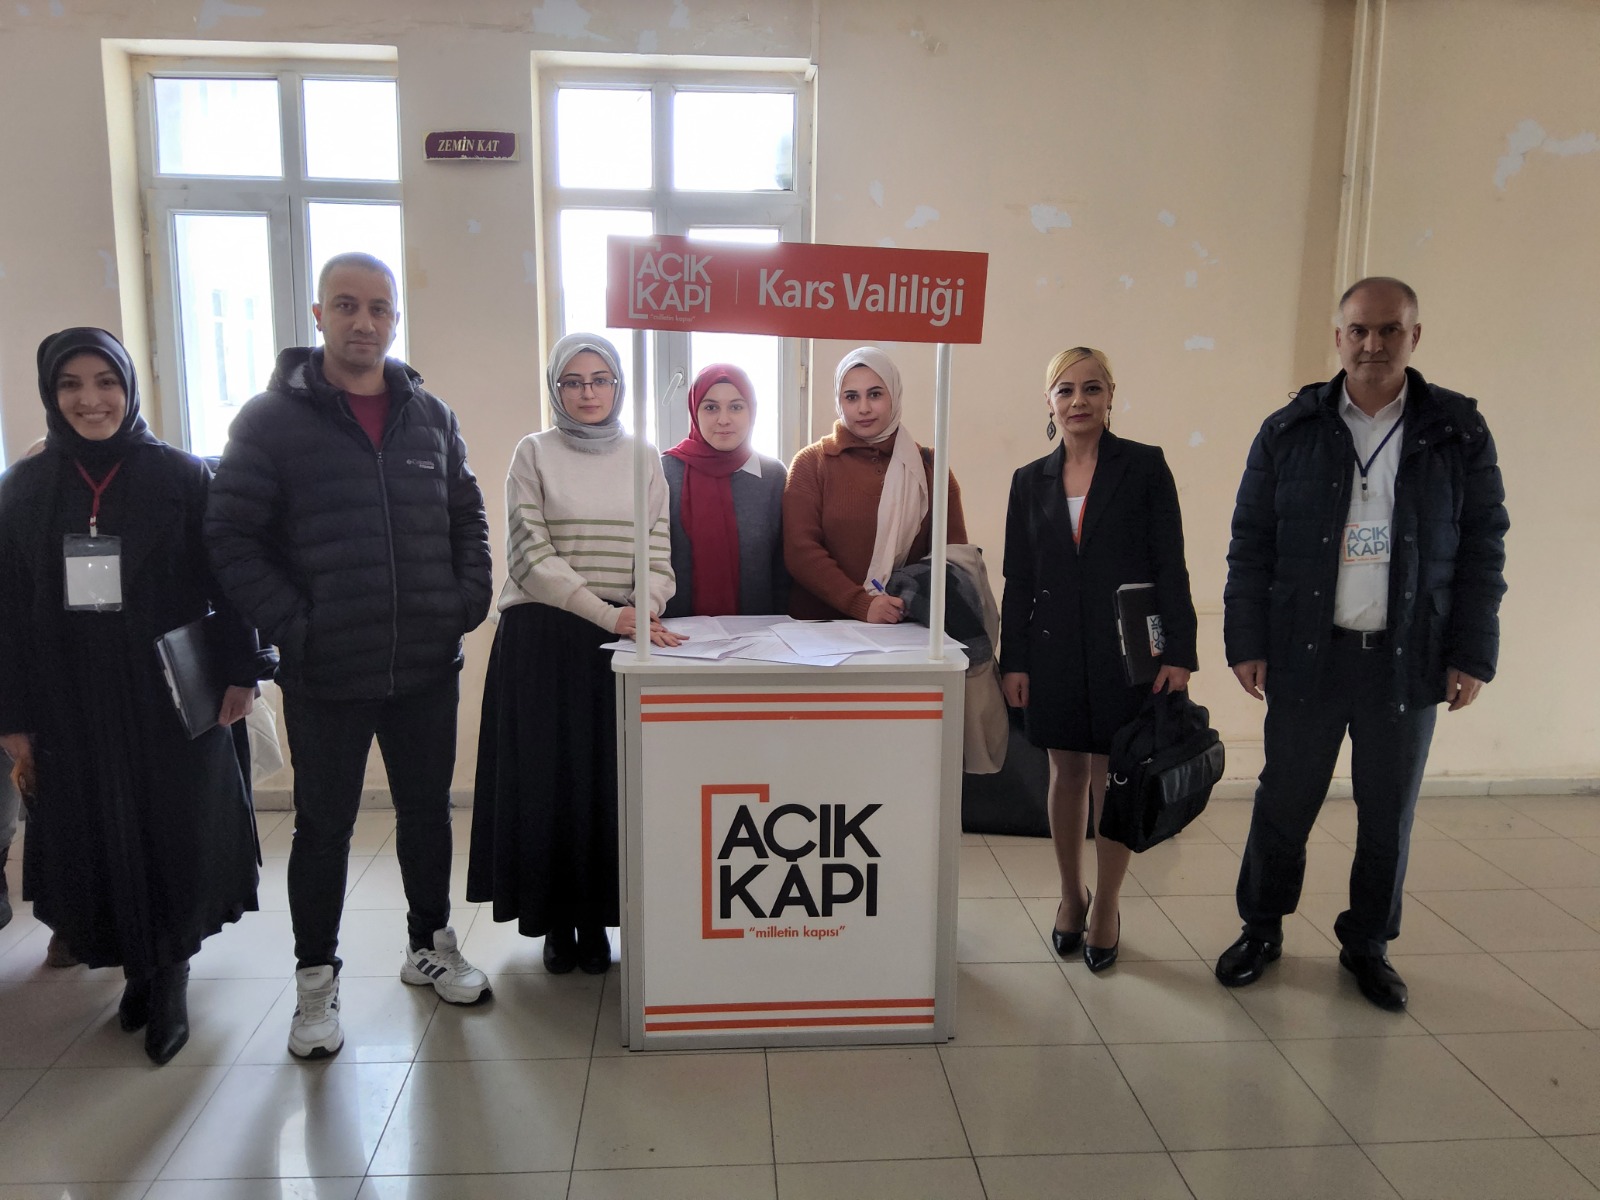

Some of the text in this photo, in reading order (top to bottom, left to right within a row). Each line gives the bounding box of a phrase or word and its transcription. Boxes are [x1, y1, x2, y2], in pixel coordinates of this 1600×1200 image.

[437, 136, 500, 152] ZEMİN KAT
[636, 252, 713, 284] AÇIK
[636, 281, 711, 313] KAPI
[758, 268, 965, 327] Kars Valiliği
[1347, 540, 1390, 557] KAPI
[717, 803, 883, 862] AÇIK
[719, 863, 878, 919] KAPI
